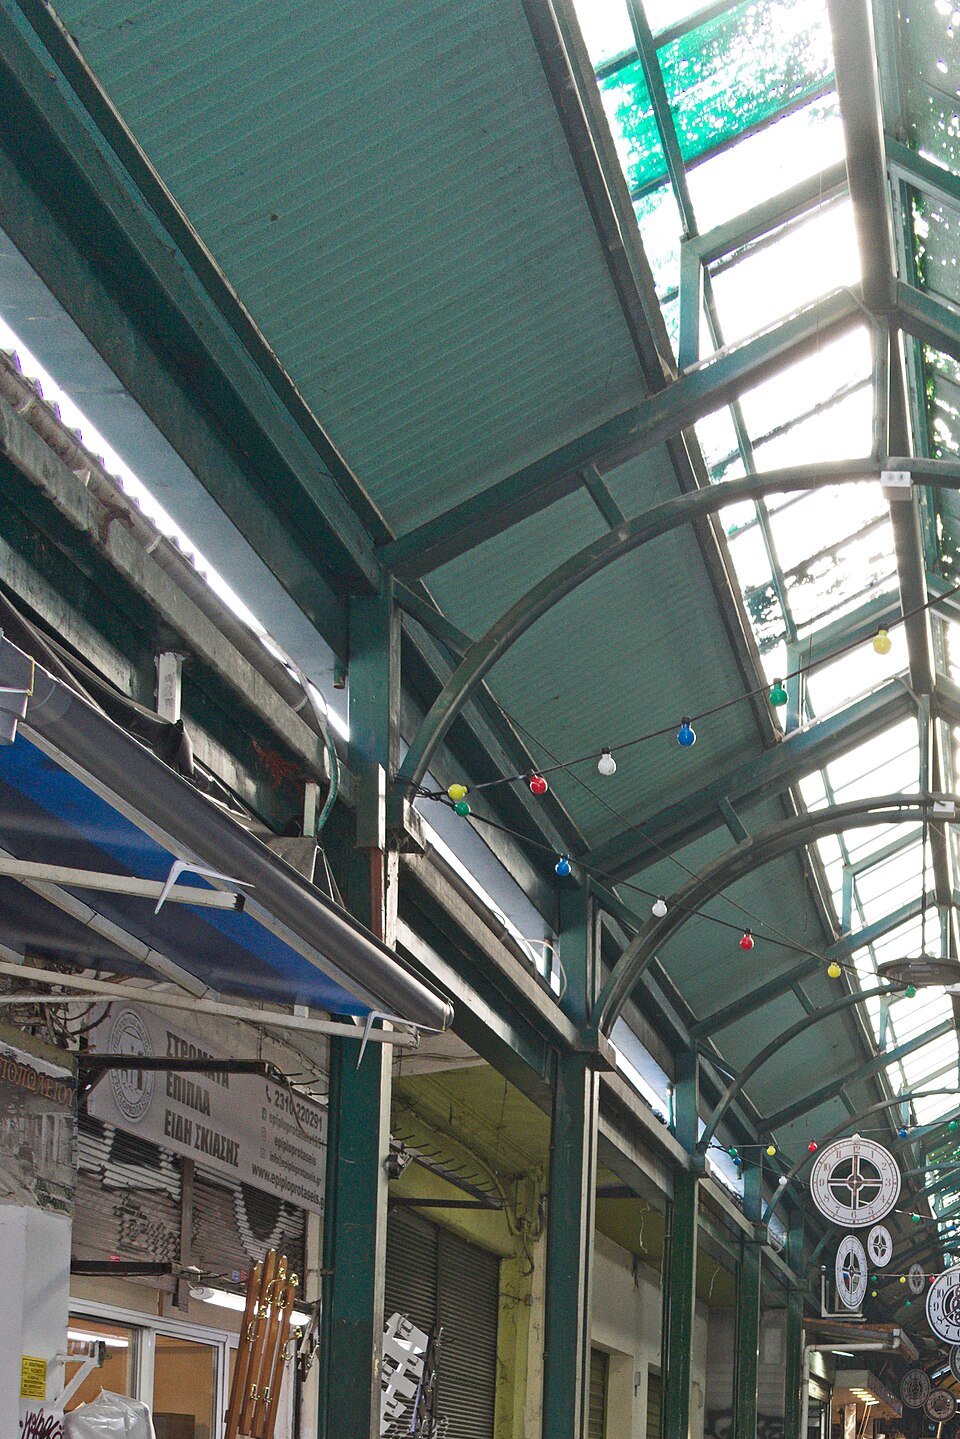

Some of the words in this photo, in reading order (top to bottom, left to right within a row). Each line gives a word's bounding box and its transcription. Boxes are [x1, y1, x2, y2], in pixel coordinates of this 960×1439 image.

[165, 1070, 211, 1117] ΕΠΙΠΛΑ
[275, 1090, 294, 1115] 2310
[296, 1102, 322, 1132] 220291
[164, 1109, 193, 1146] ΕΙΔΗ
[194, 1123, 240, 1168] ΣΚΙΑΣΗΣ
